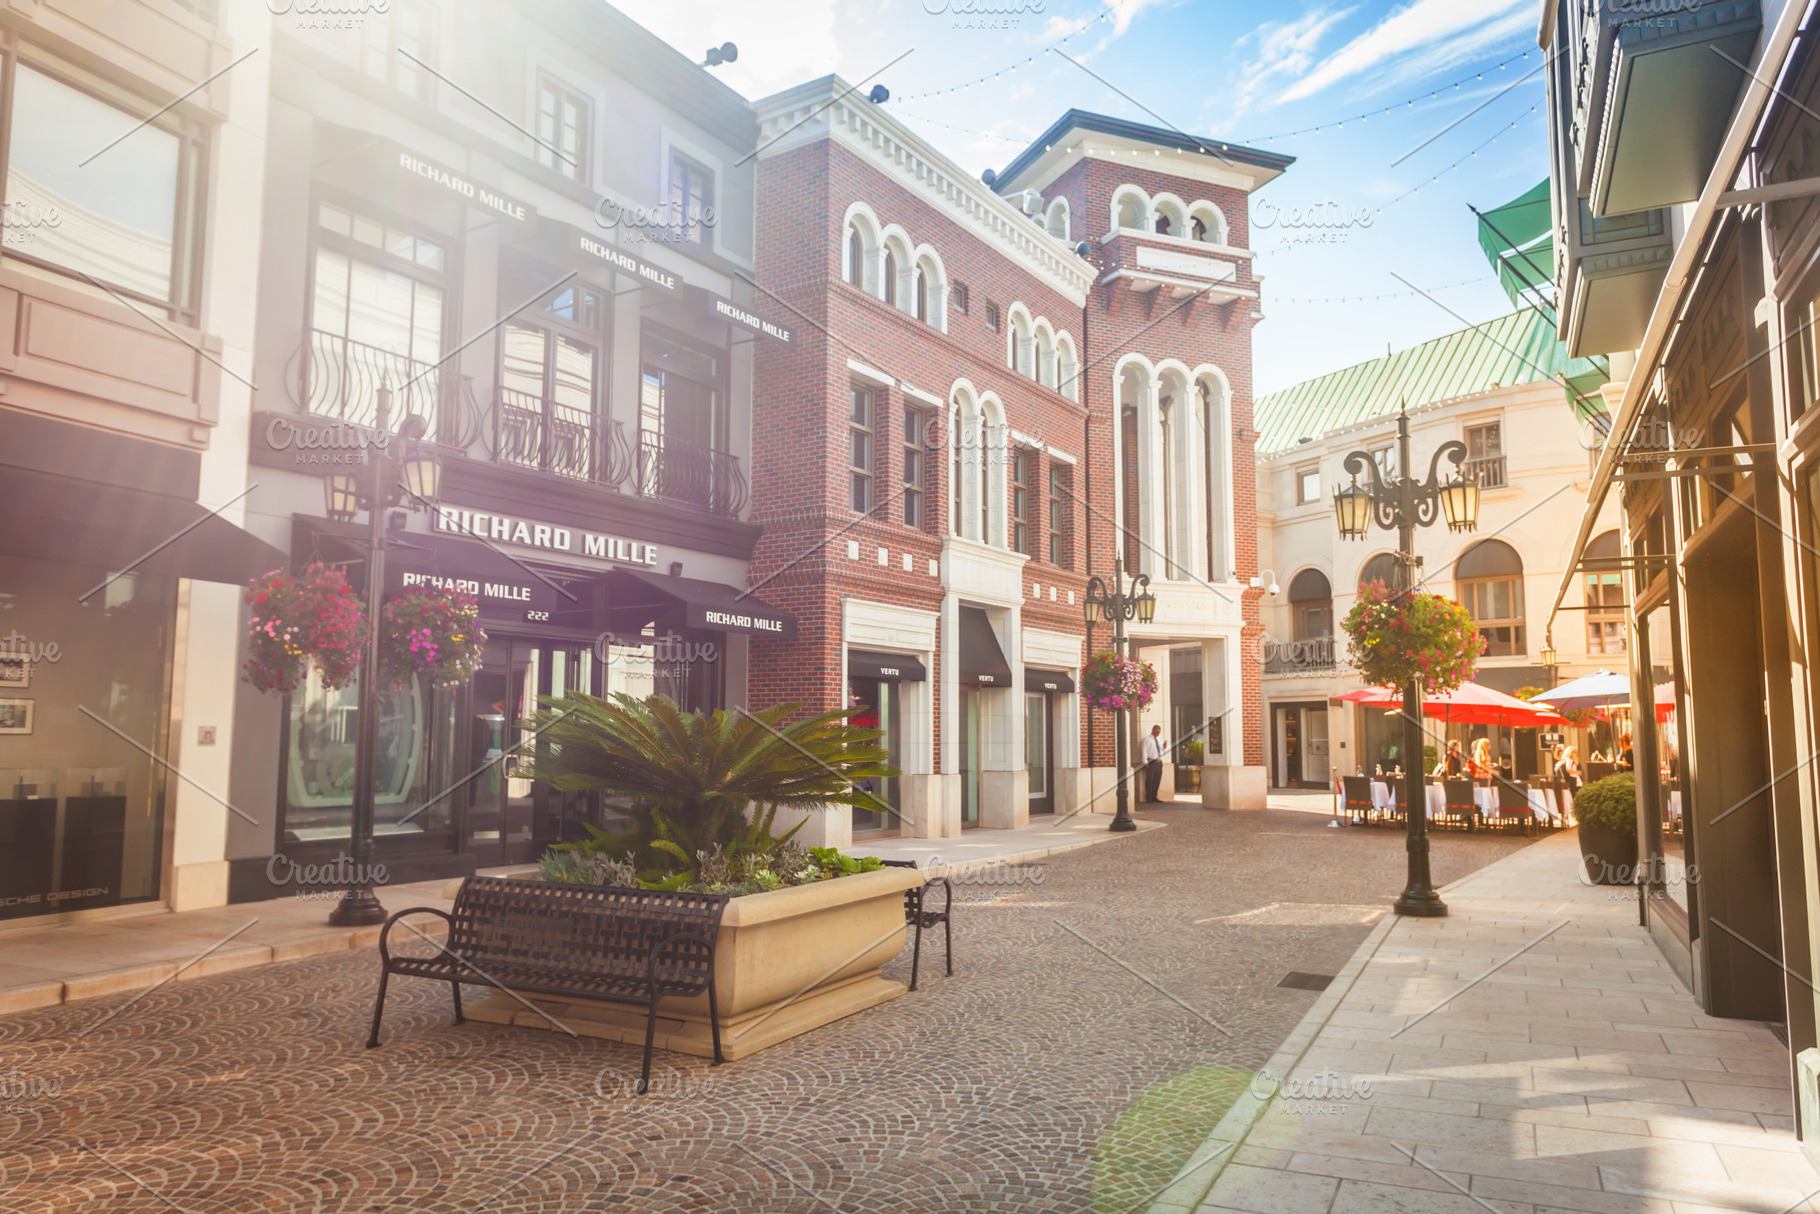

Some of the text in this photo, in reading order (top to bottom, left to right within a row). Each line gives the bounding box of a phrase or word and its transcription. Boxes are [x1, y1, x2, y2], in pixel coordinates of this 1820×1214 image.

[399, 152, 525, 222] RICHARD MILLE
[579, 236, 675, 290] RICHARD MILLE
[716, 300, 790, 342] RICHARD MILLE
[438, 506, 658, 566] RICHARD MILLE
[403, 572, 531, 602] RICHARD MILLE
[527, 610, 549, 622] 222
[705, 611, 783, 632] RICHARD MILLE
[880, 667, 899, 676] VERTU
[978, 674, 994, 683] VERTU
[1044, 682, 1057, 690] VERTU
[46, 886, 109, 902] DESIGN
